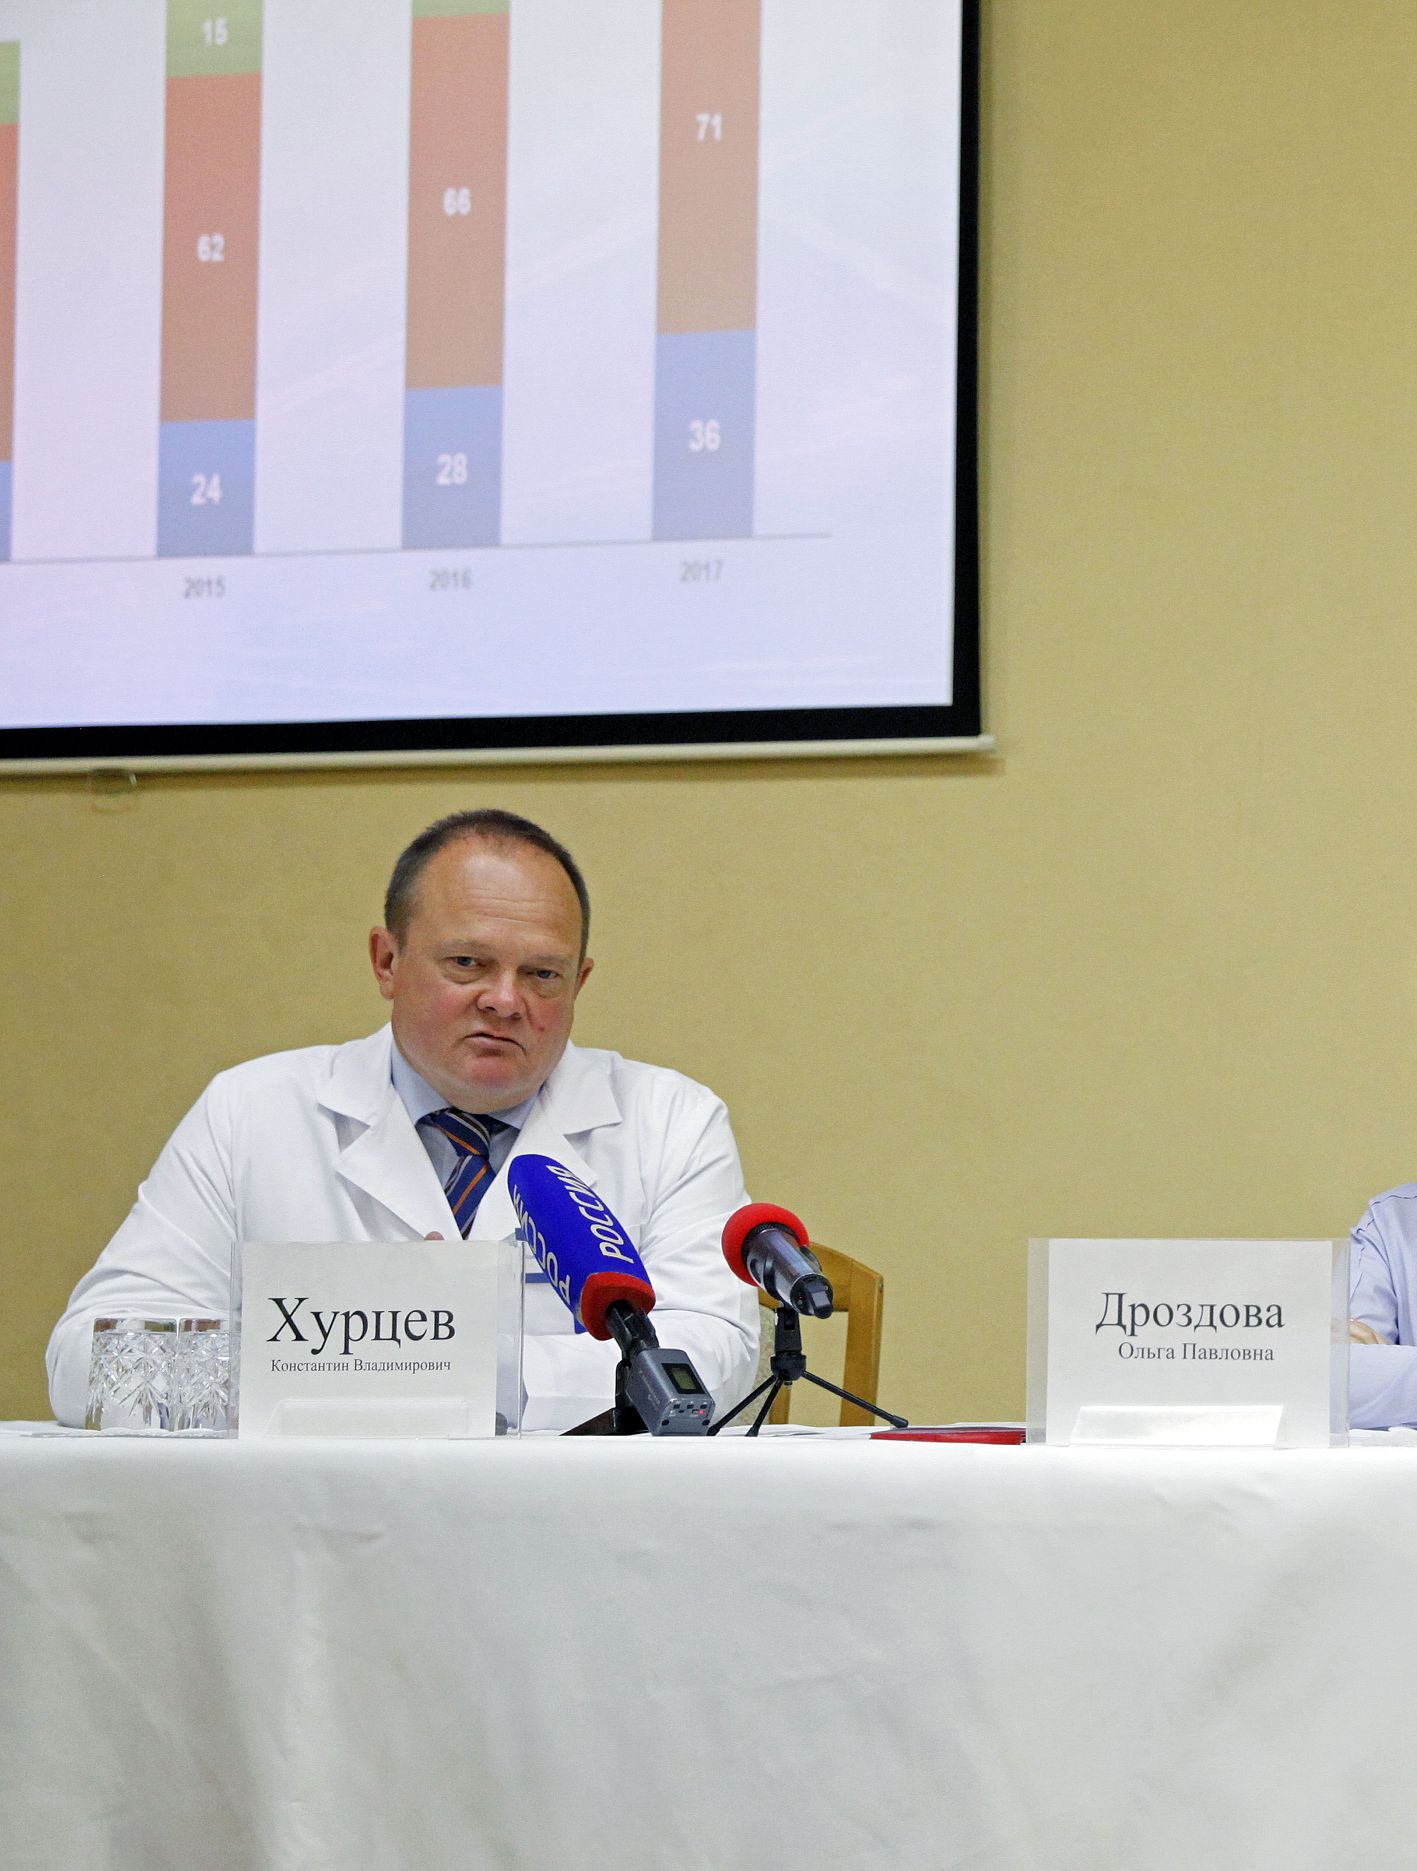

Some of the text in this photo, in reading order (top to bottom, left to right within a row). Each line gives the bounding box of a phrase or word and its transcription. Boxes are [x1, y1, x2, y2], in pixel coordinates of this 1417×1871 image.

[202, 17, 229, 46] 15
[695, 112, 722, 142] 71
[443, 186, 472, 215] 66
[197, 233, 225, 262] 62
[688, 419, 721, 451] 36
[436, 452, 469, 486] 28
[190, 473, 222, 506] 24
[183, 559, 724, 600] 2015 2016 2017
[545, 1164, 635, 1265] РОССИЯ
[266, 1297, 456, 1356] Хурцев
[1095, 1292, 1285, 1337] Дроздова
[271, 1358, 451, 1374] Константин Владимирович
[1118, 1342, 1275, 1361] Ольга Павловна
